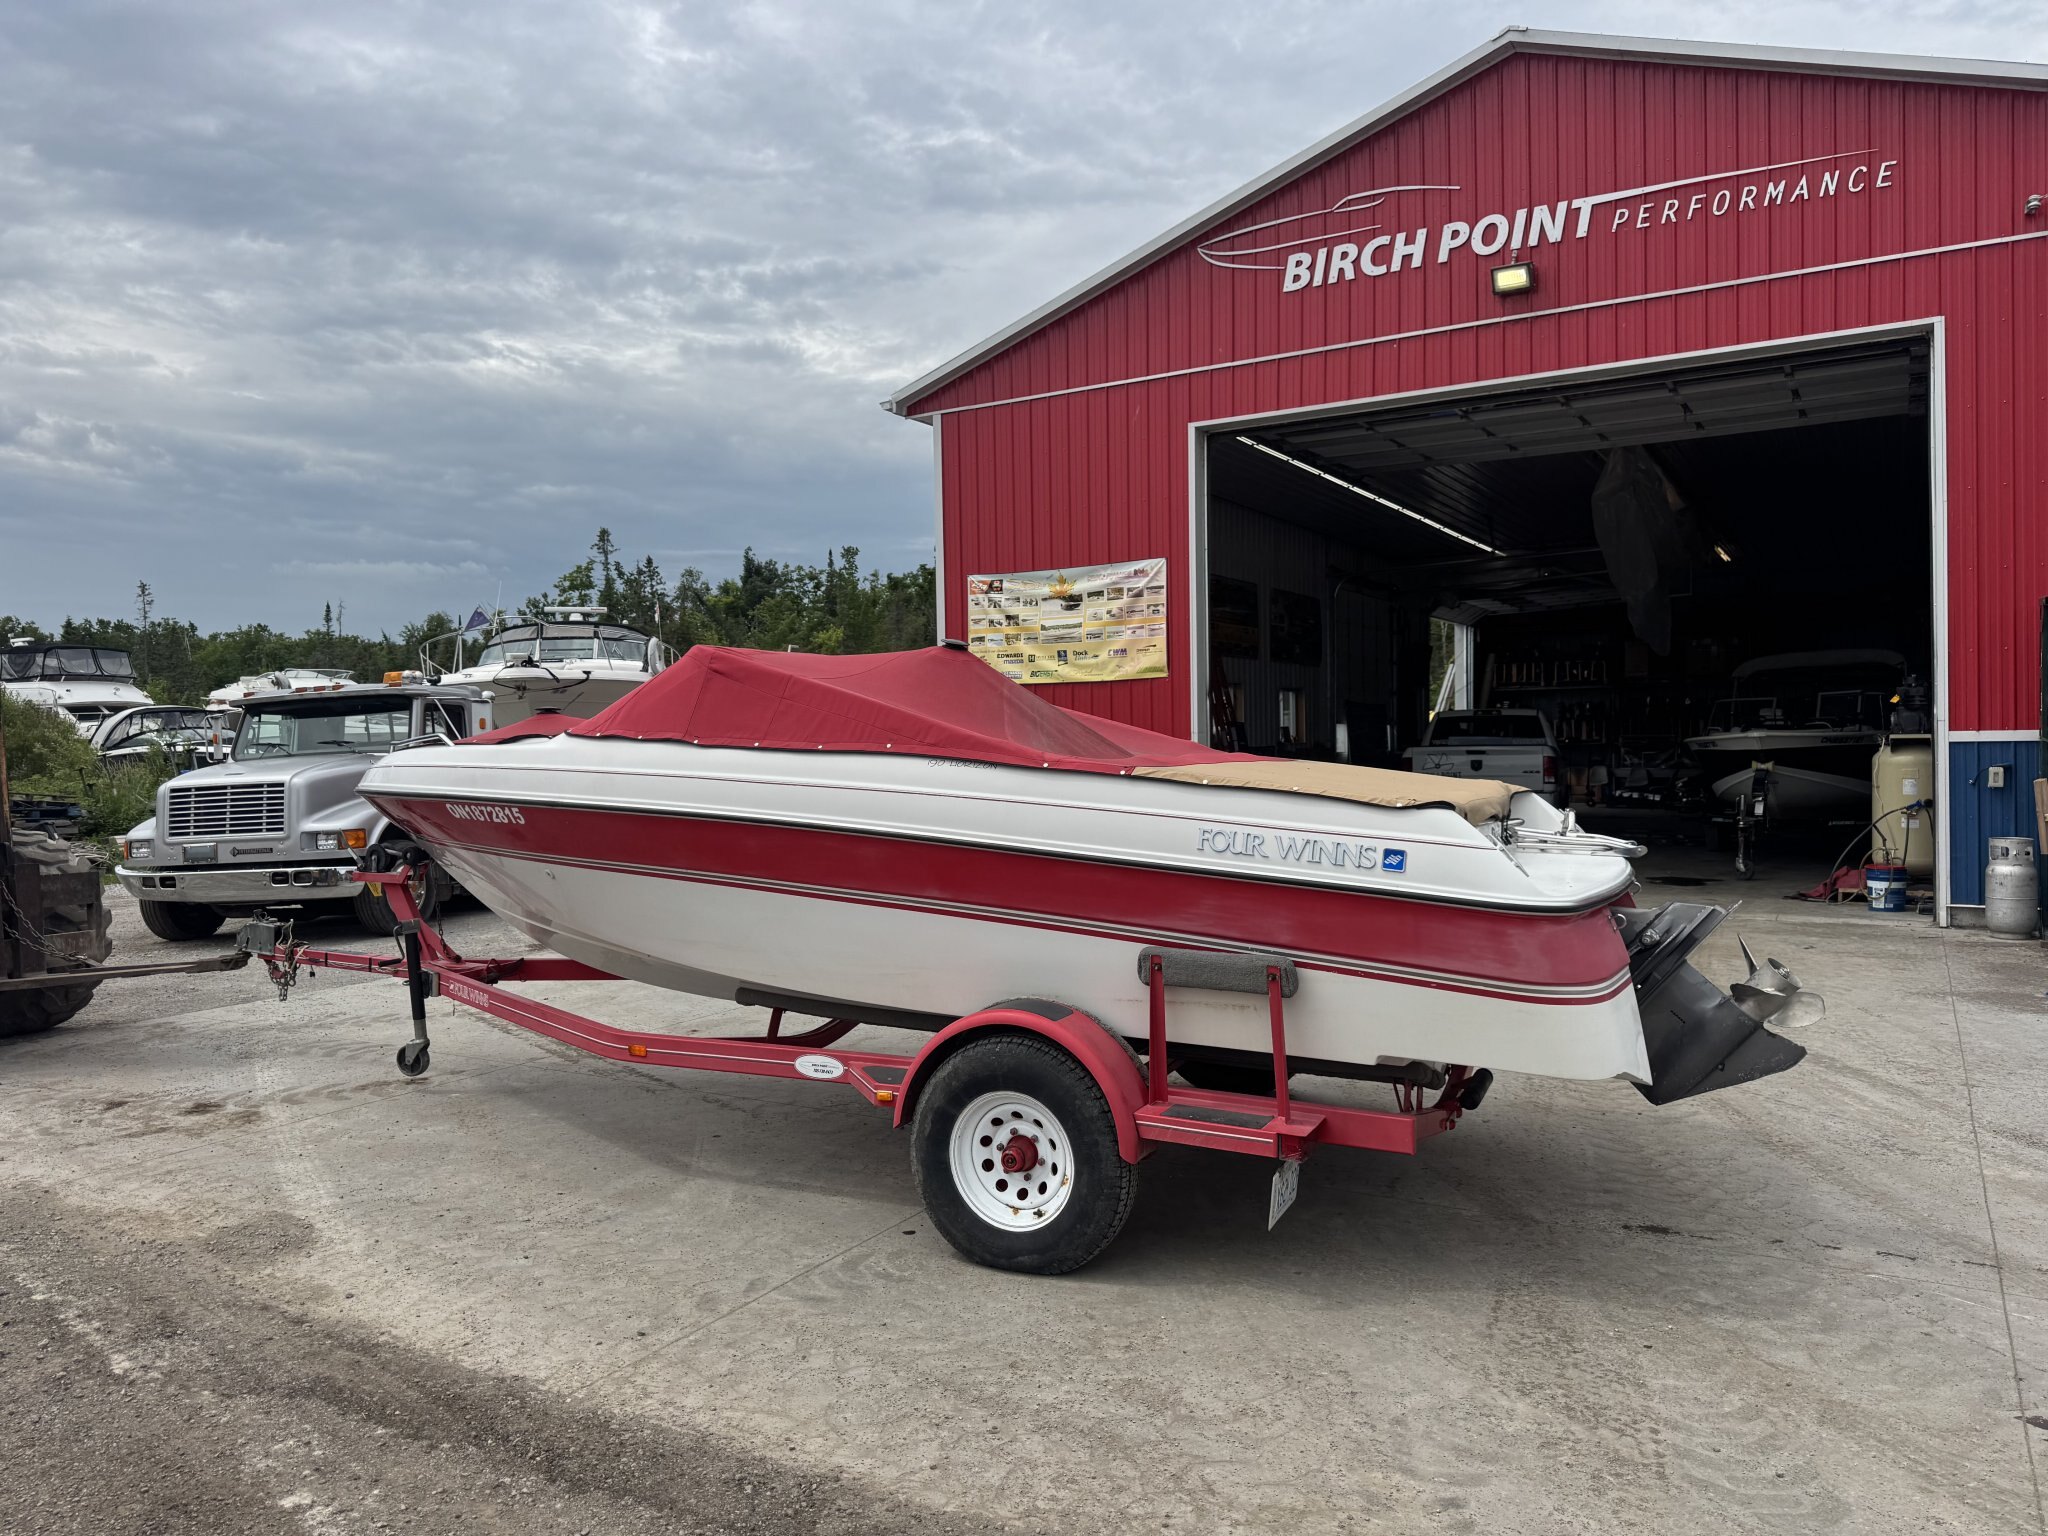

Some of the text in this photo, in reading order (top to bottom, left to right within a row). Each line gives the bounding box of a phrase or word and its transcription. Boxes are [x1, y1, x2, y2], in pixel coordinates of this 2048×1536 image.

[1283, 160, 1898, 293] BIRCH POINT PERFORMANCE
[445, 803, 525, 824] ON1872815
[1197, 827, 1378, 870] FOUR WINNS
